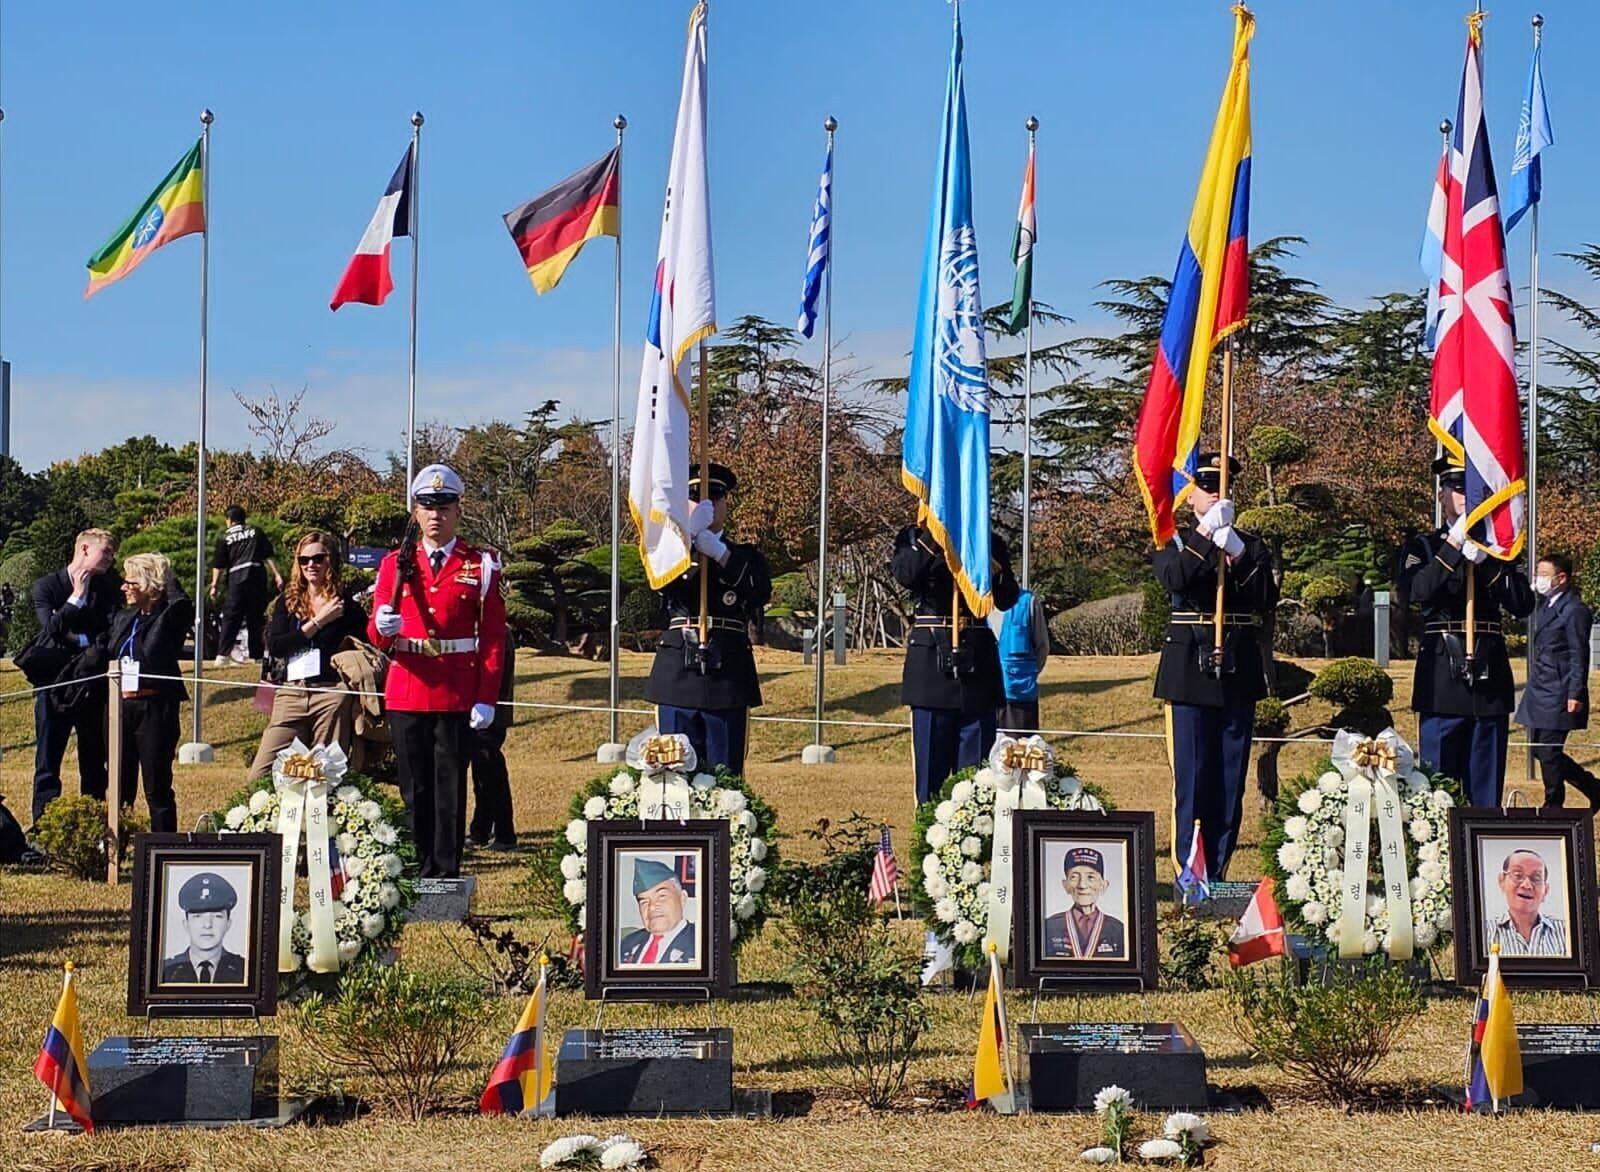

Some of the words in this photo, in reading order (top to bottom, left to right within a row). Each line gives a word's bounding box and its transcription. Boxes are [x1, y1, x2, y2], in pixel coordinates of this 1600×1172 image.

[311, 807, 325, 906] 윤석열
[1350, 801, 1365, 901] 대통령
[1383, 800, 1402, 900] 윤석열
